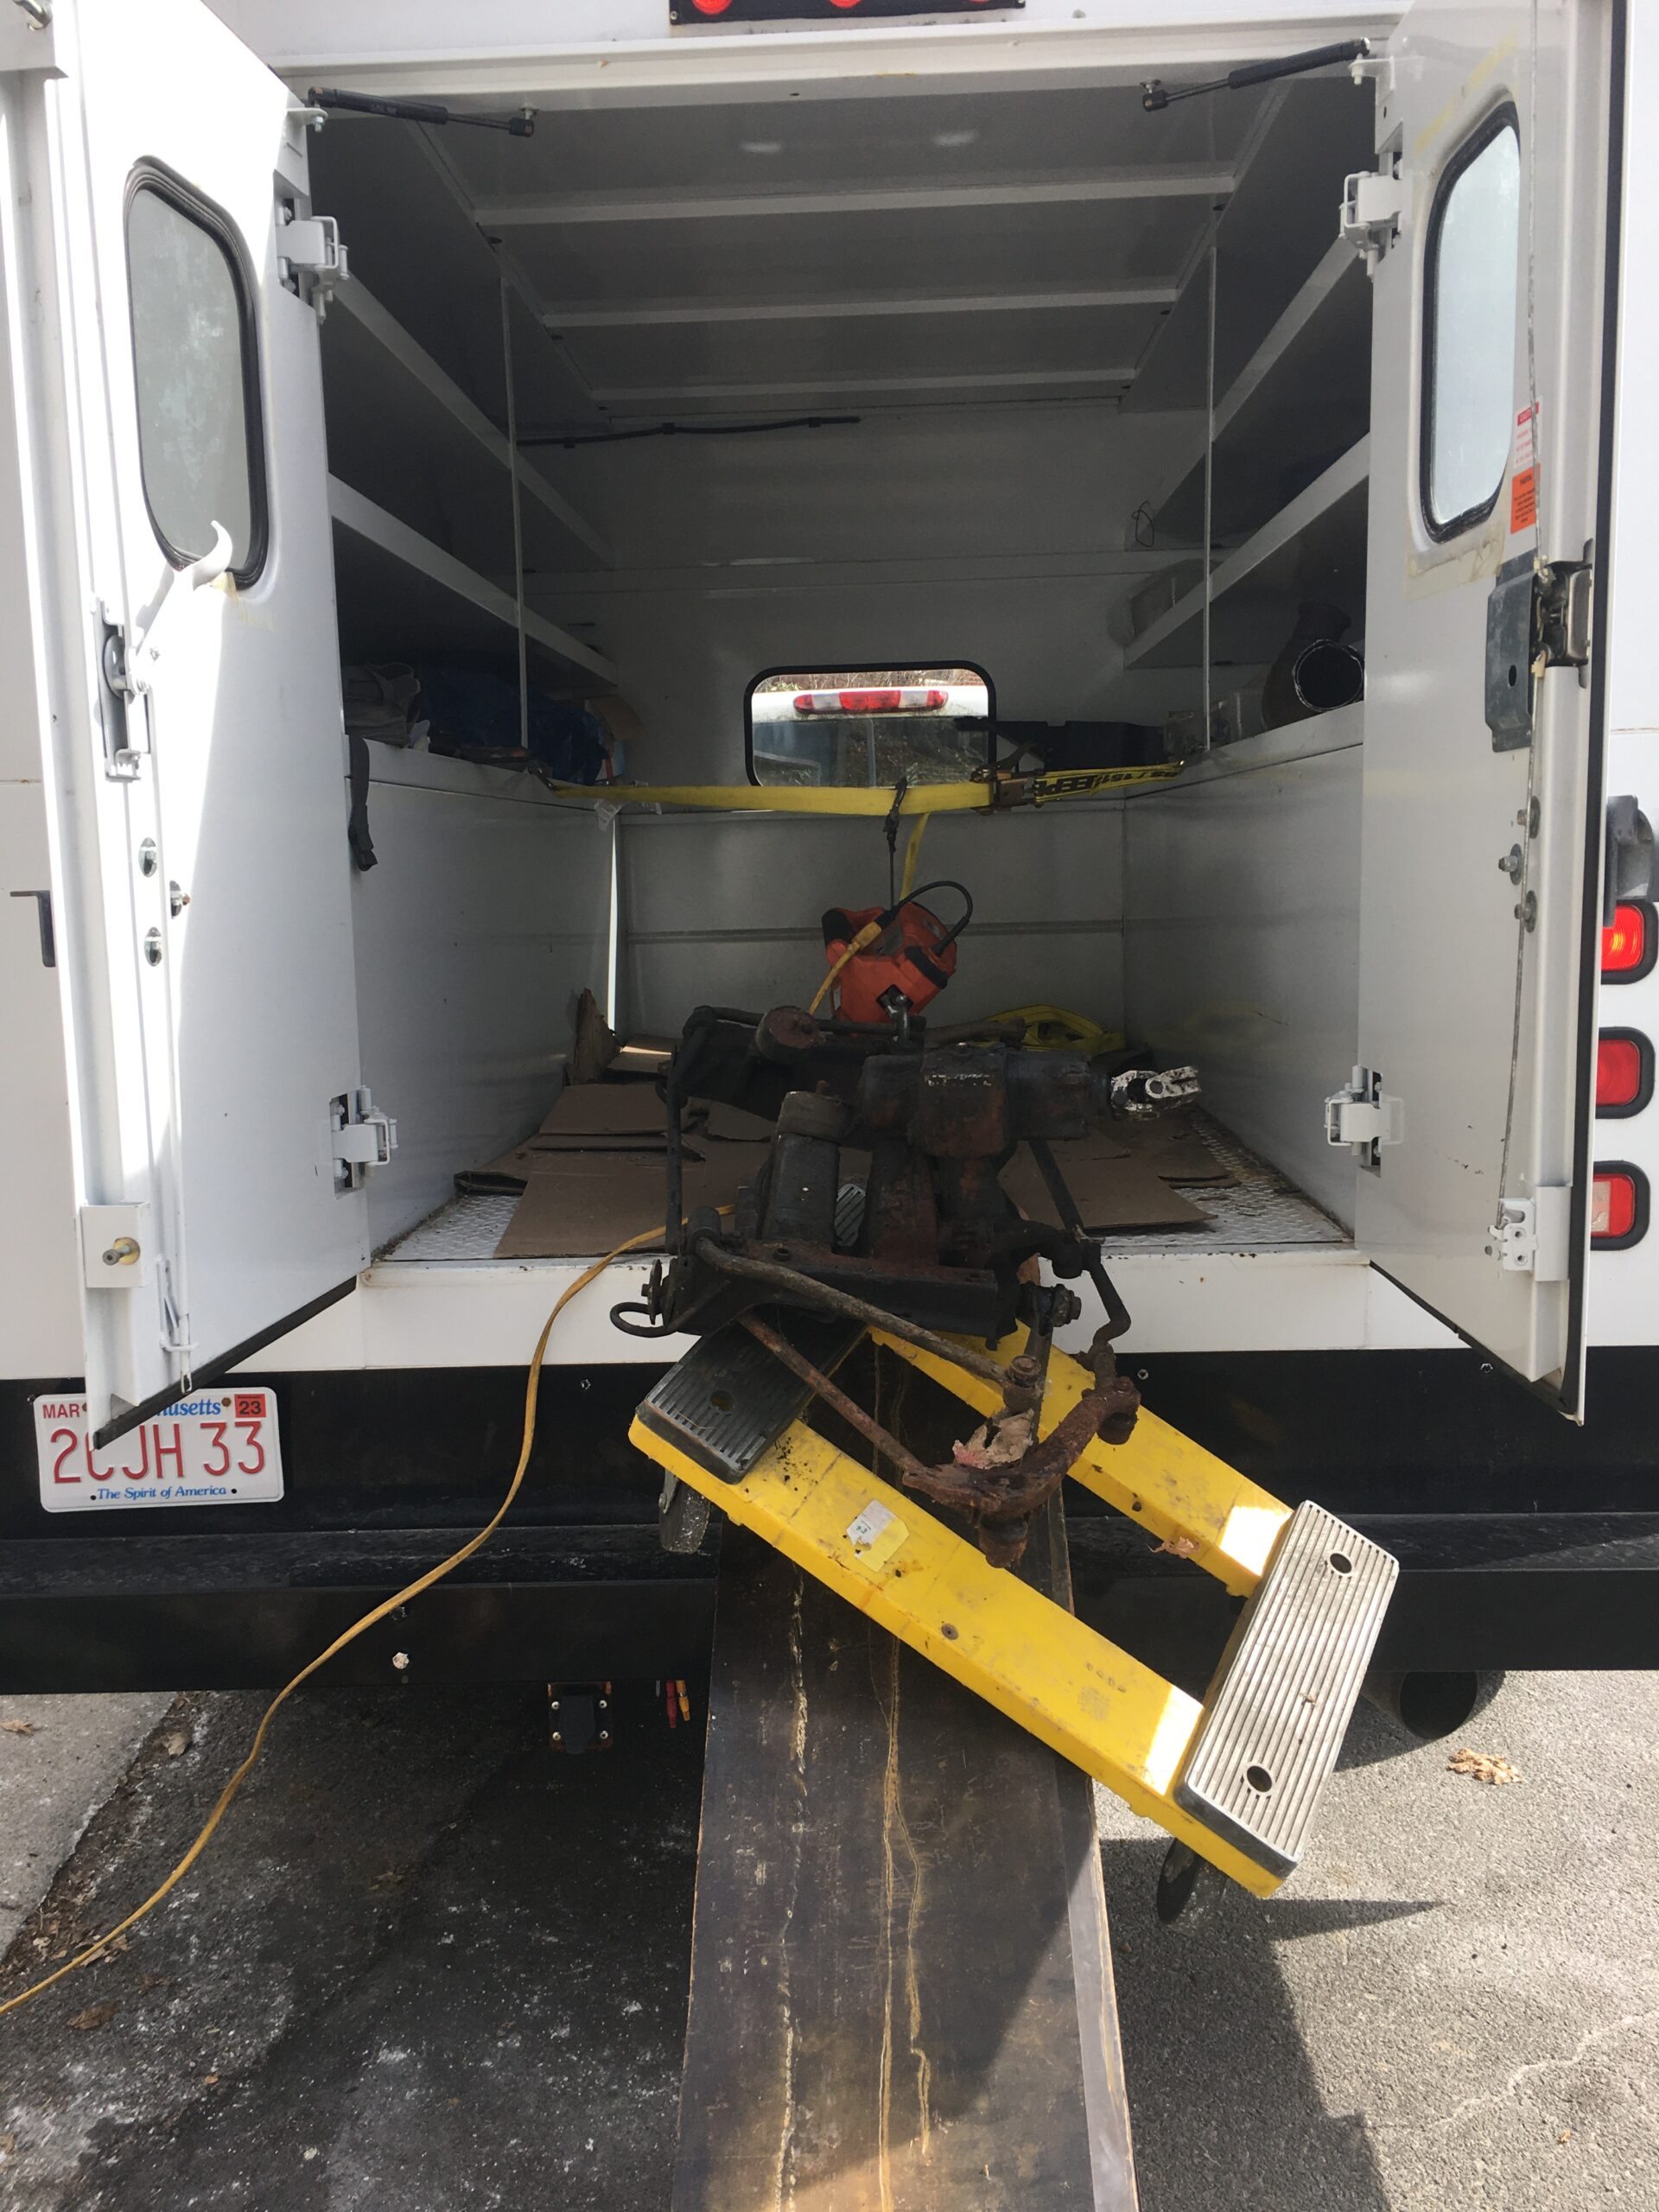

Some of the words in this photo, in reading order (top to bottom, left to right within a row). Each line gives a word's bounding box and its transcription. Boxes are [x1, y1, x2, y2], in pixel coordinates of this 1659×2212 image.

[42, 1403, 80, 1419] MAR
[238, 1401, 262, 1414] 23
[200, 1421, 265, 1477] 33
[97, 1488, 121, 1500] The
[124, 1486, 157, 1501] Spirit
[160, 1486, 173, 1499] of
[175, 1484, 227, 1497] America
